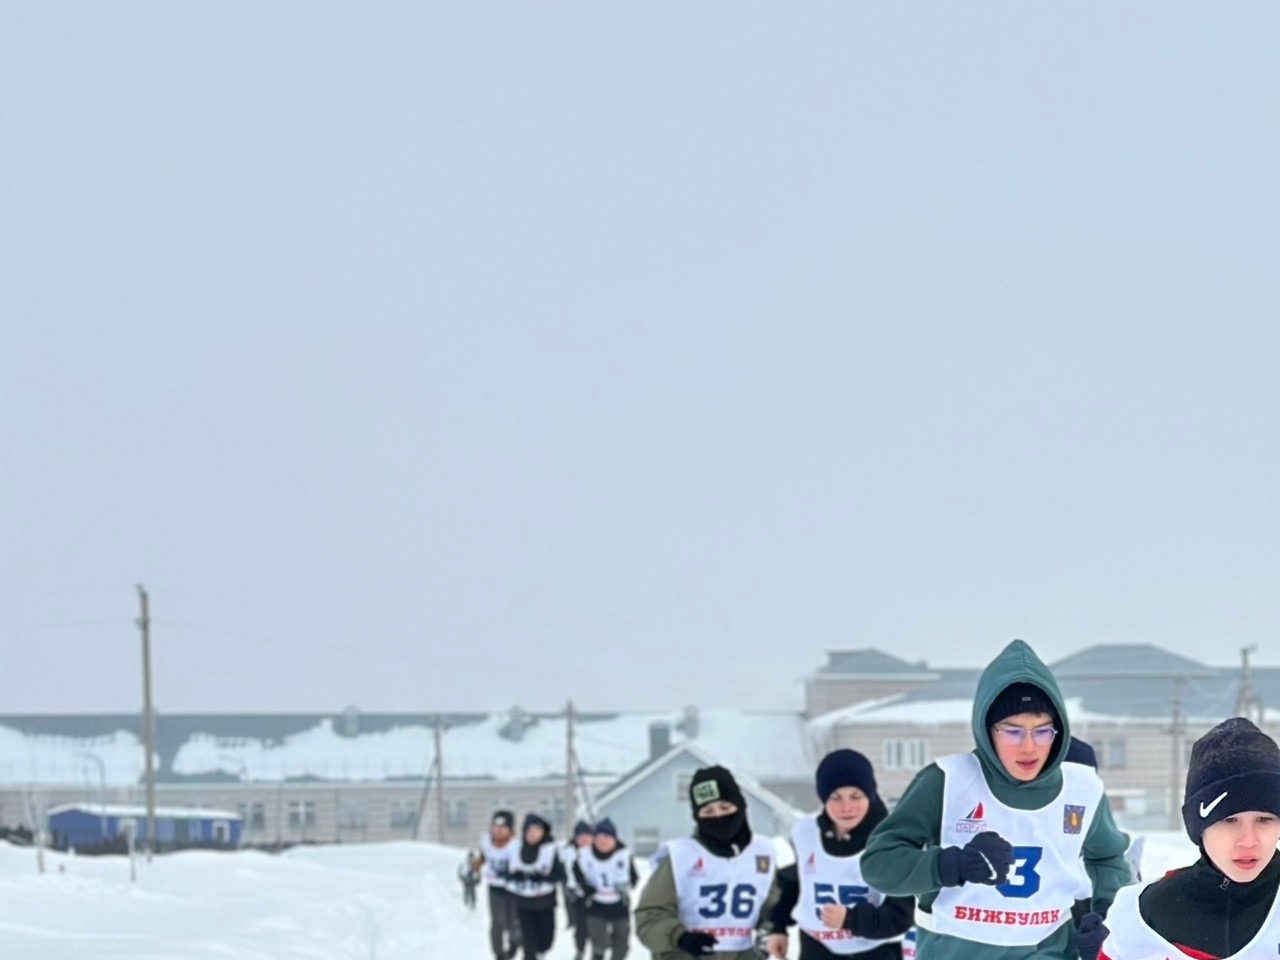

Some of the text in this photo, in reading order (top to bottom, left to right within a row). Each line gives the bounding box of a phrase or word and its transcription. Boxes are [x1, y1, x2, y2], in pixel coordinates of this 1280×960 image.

[995, 846, 1043, 898] 3
[699, 883, 755, 918] 36
[954, 906, 1061, 925] БИЖБУЛЯК
